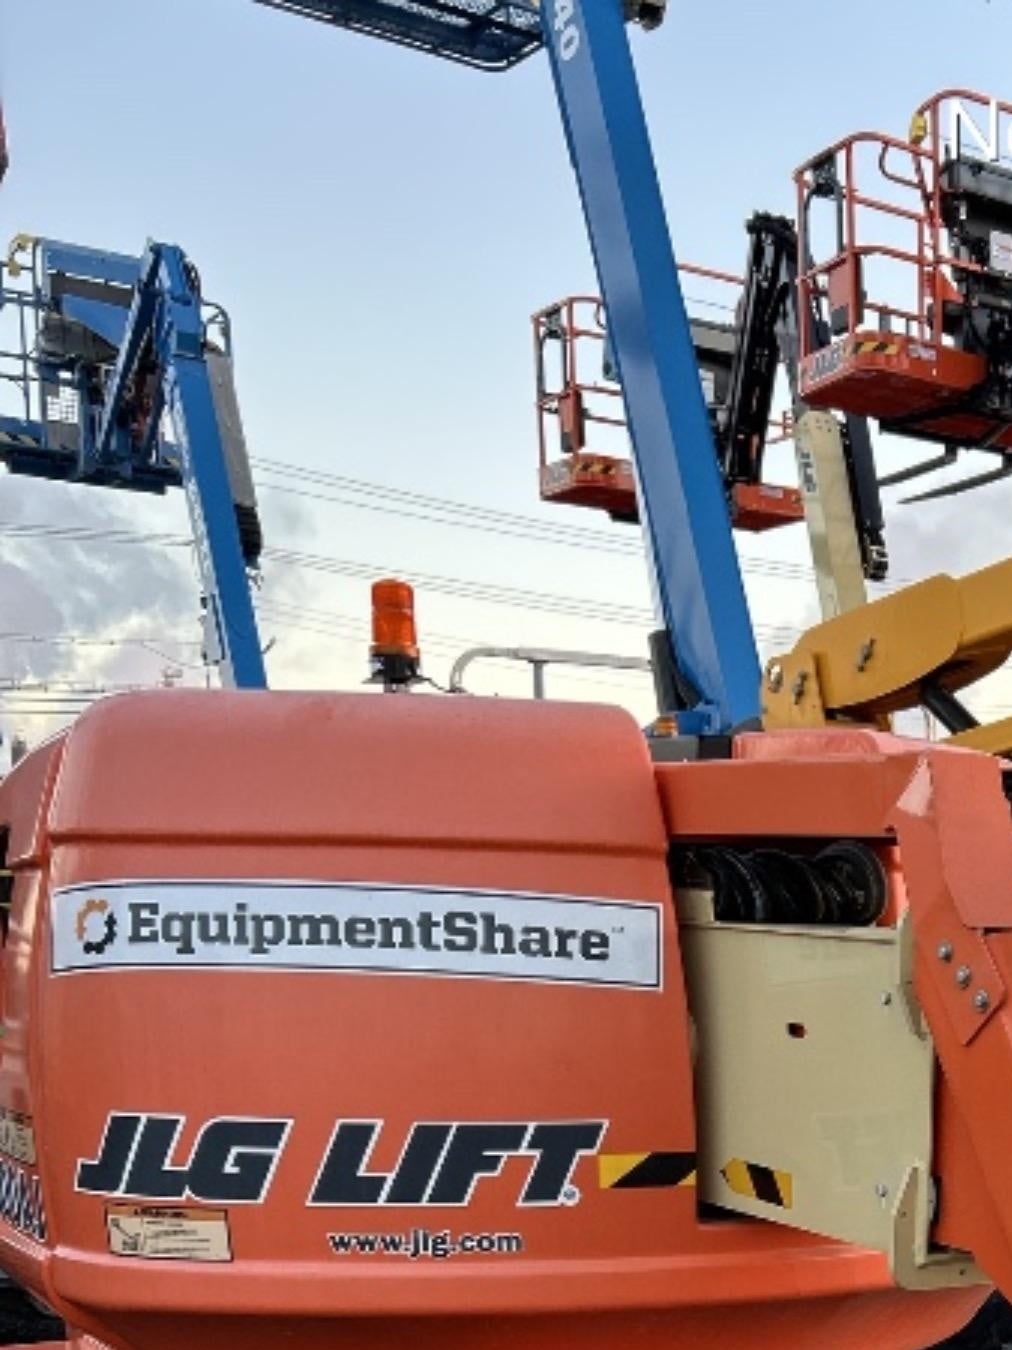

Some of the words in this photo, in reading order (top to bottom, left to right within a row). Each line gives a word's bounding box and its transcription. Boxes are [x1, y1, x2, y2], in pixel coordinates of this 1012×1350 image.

[127, 902, 610, 961] EquipmentShare
[74, 1111, 295, 1204] JLG
[305, 1118, 610, 1207] LIFT
[327, 1230, 523, 1259] www.jlg.com
